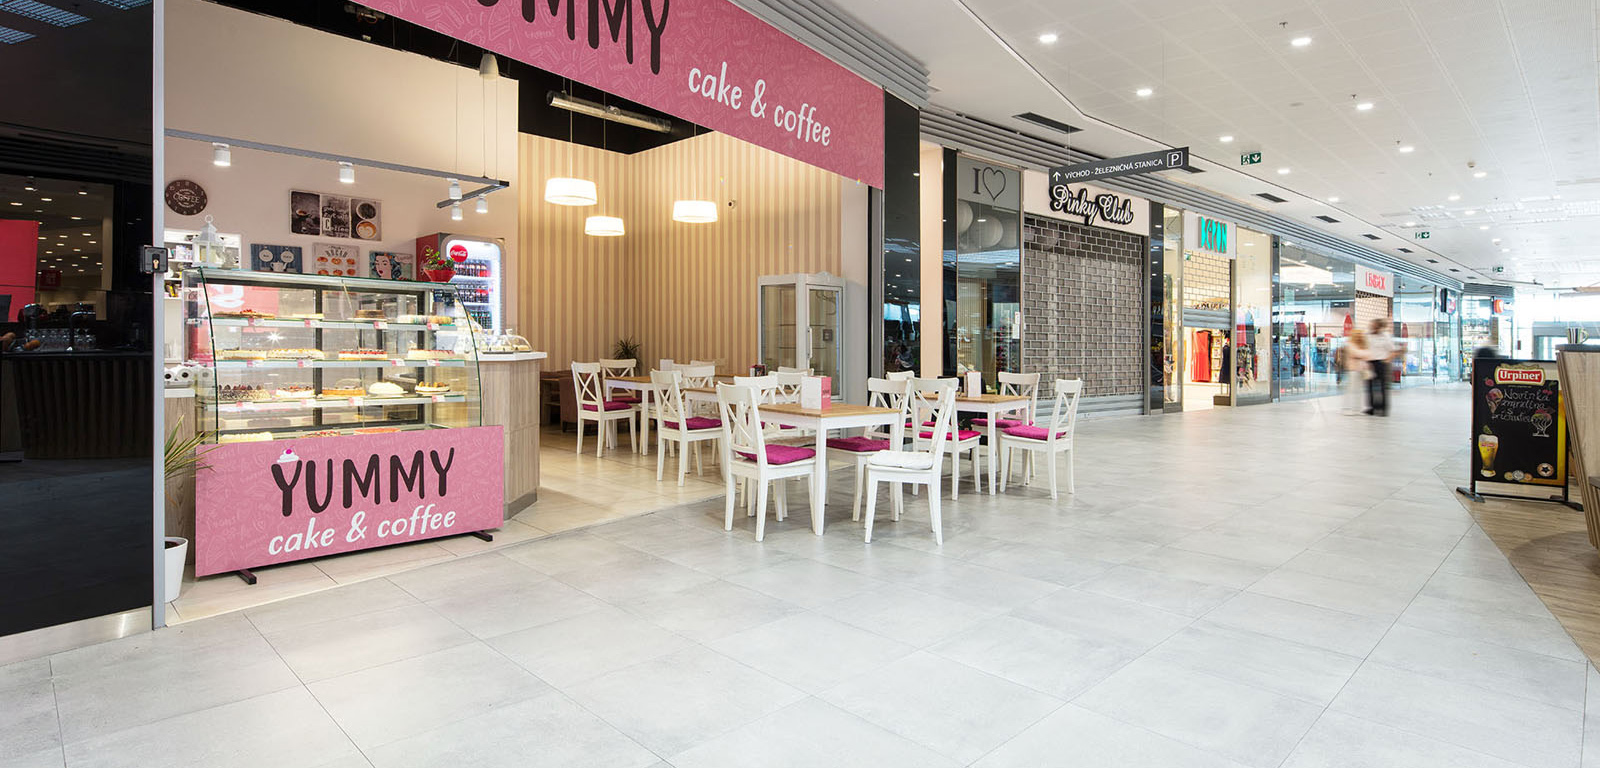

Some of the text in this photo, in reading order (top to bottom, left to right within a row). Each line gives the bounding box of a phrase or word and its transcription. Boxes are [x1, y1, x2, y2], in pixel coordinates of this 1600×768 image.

[688, 61, 831, 146] cake & coffee
[1064, 169, 1090, 179] VÝCHOD
[1134, 158, 1163, 169] STANICA
[1171, 153, 1180, 166] P
[1052, 184, 1134, 226] Pinky Club
[1499, 370, 1541, 381] Urpiner
[271, 447, 455, 517] YUMMY
[268, 503, 456, 556] cake & coffee
